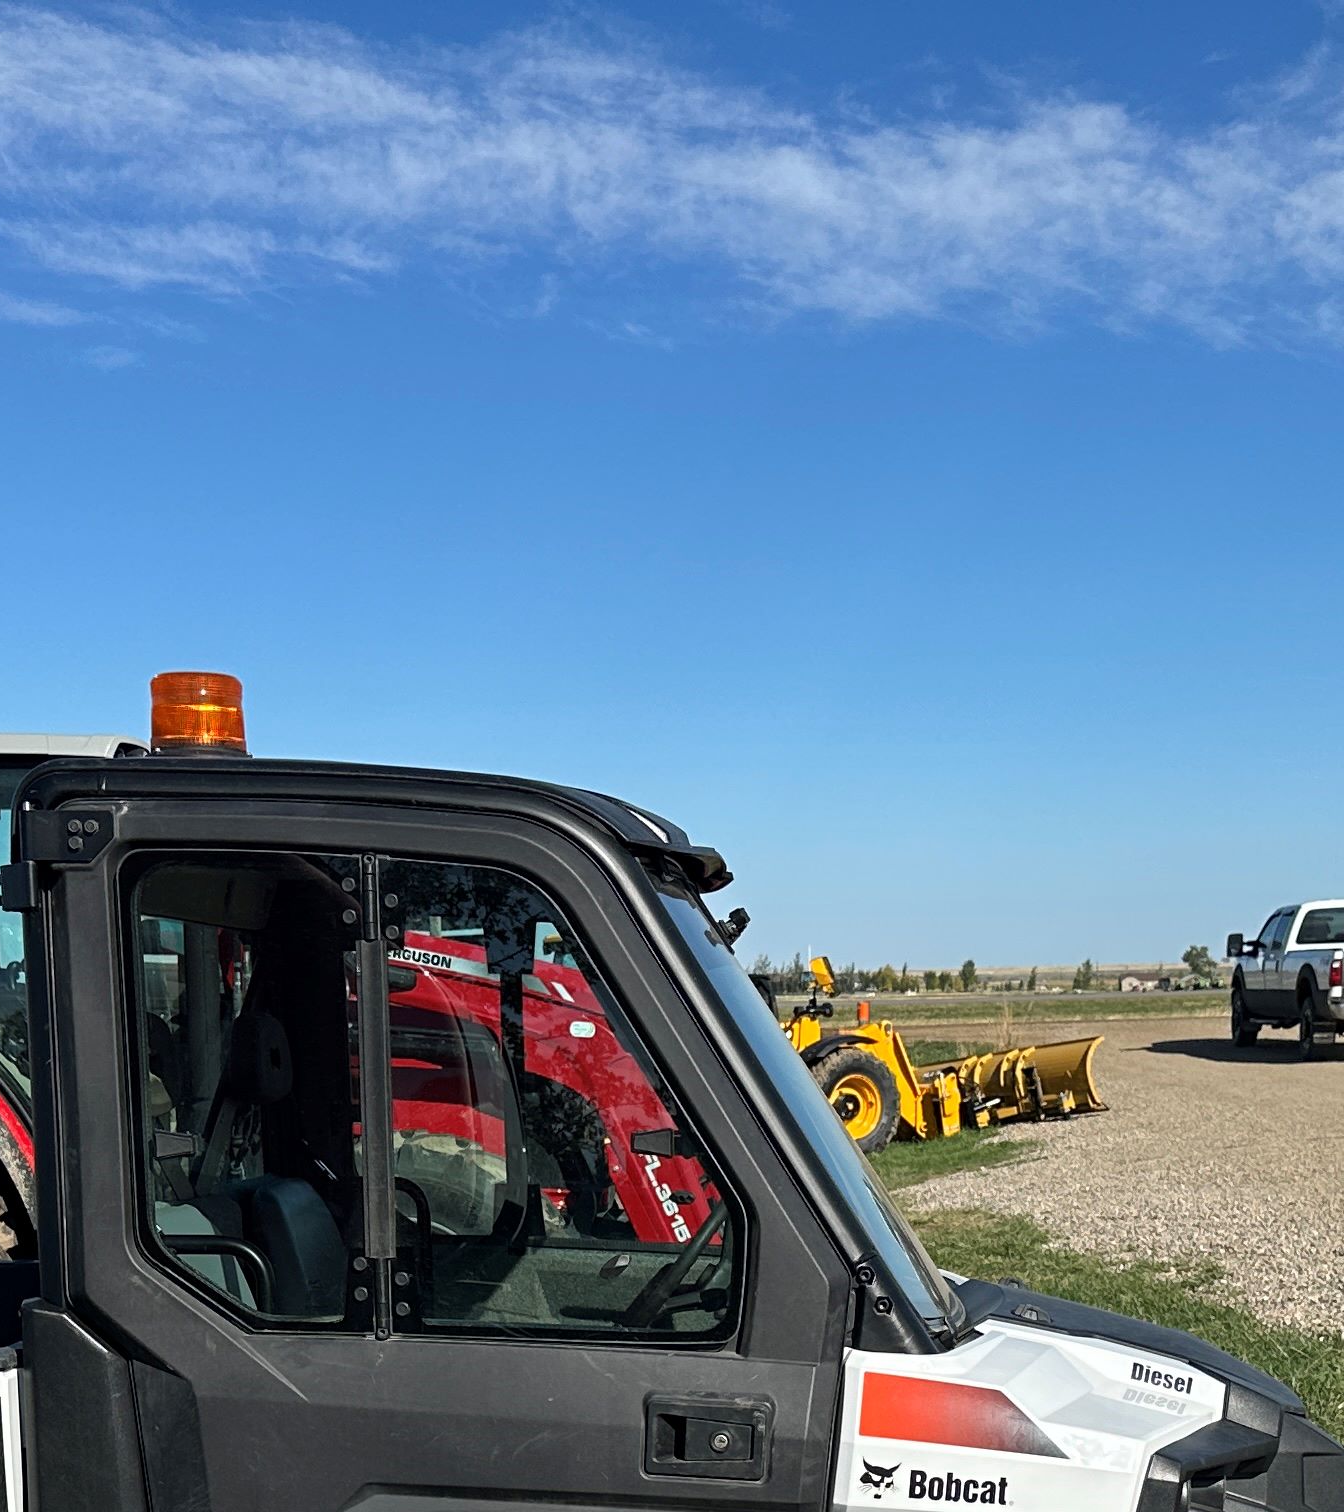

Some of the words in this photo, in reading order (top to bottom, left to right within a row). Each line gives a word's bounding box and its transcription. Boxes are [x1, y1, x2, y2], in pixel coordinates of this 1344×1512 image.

[387, 948, 452, 968] ERGUSON
[1131, 1362, 1193, 1395] Diesel
[908, 1470, 1009, 1506] Bobcat
